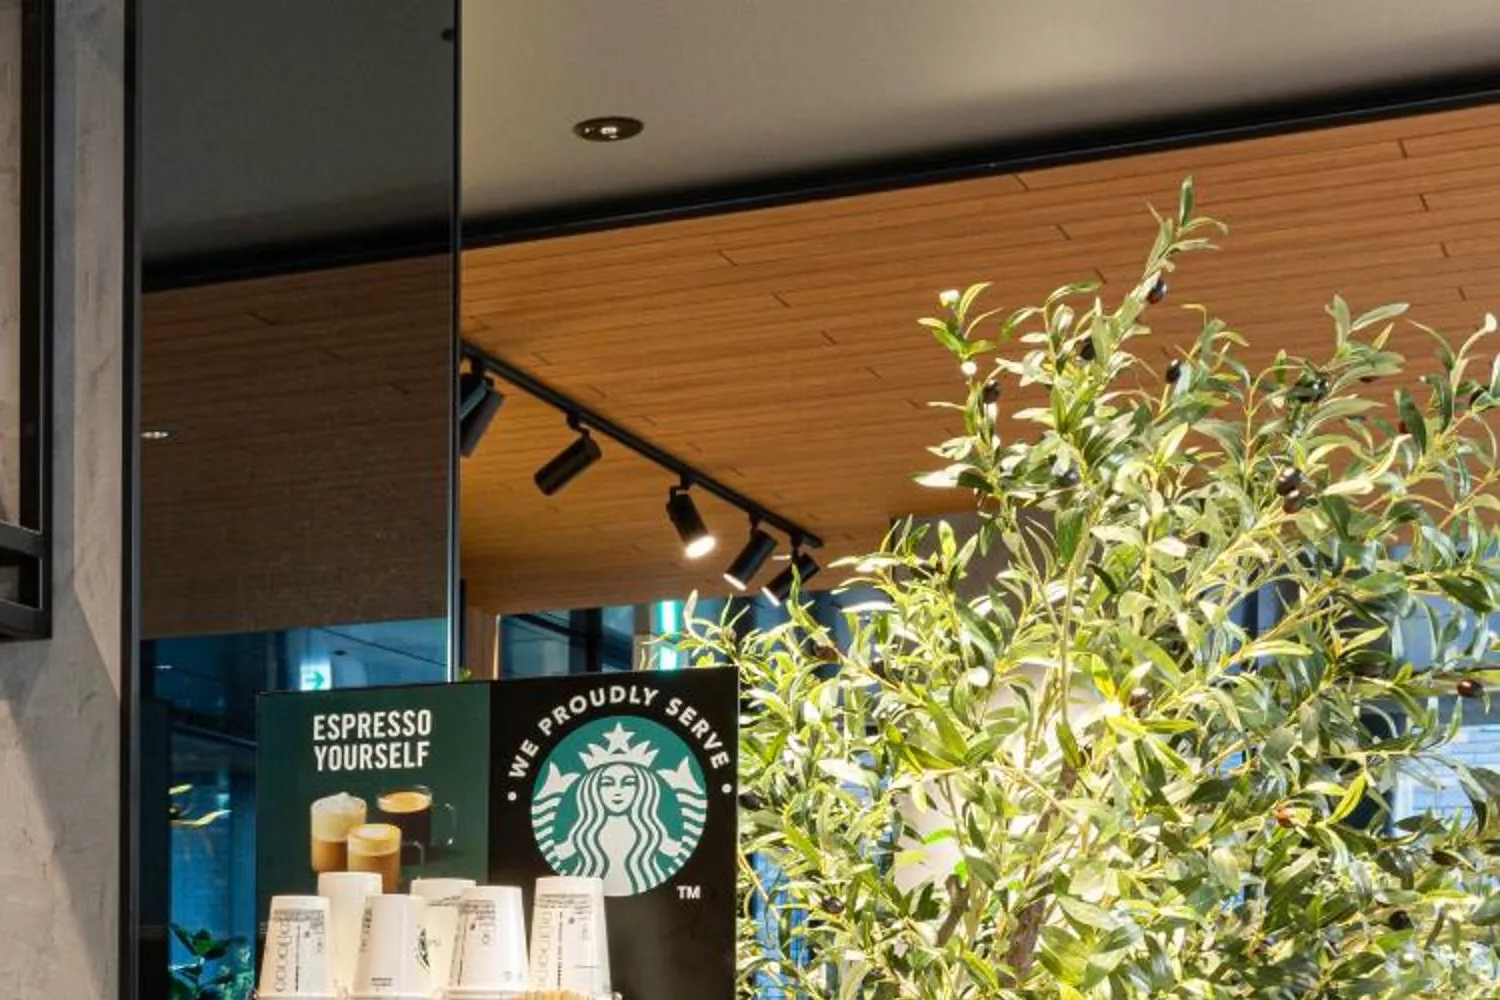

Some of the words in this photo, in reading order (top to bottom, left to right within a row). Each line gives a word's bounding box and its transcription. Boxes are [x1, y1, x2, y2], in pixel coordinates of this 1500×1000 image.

[313, 708, 432, 741] ESPRESSO
[508, 739, 539, 779] WE
[538, 685, 659, 736] PROUDLY
[665, 697, 730, 769] SERVE
[313, 740, 431, 772] YOURSELF
[676, 885, 701, 899] TM
